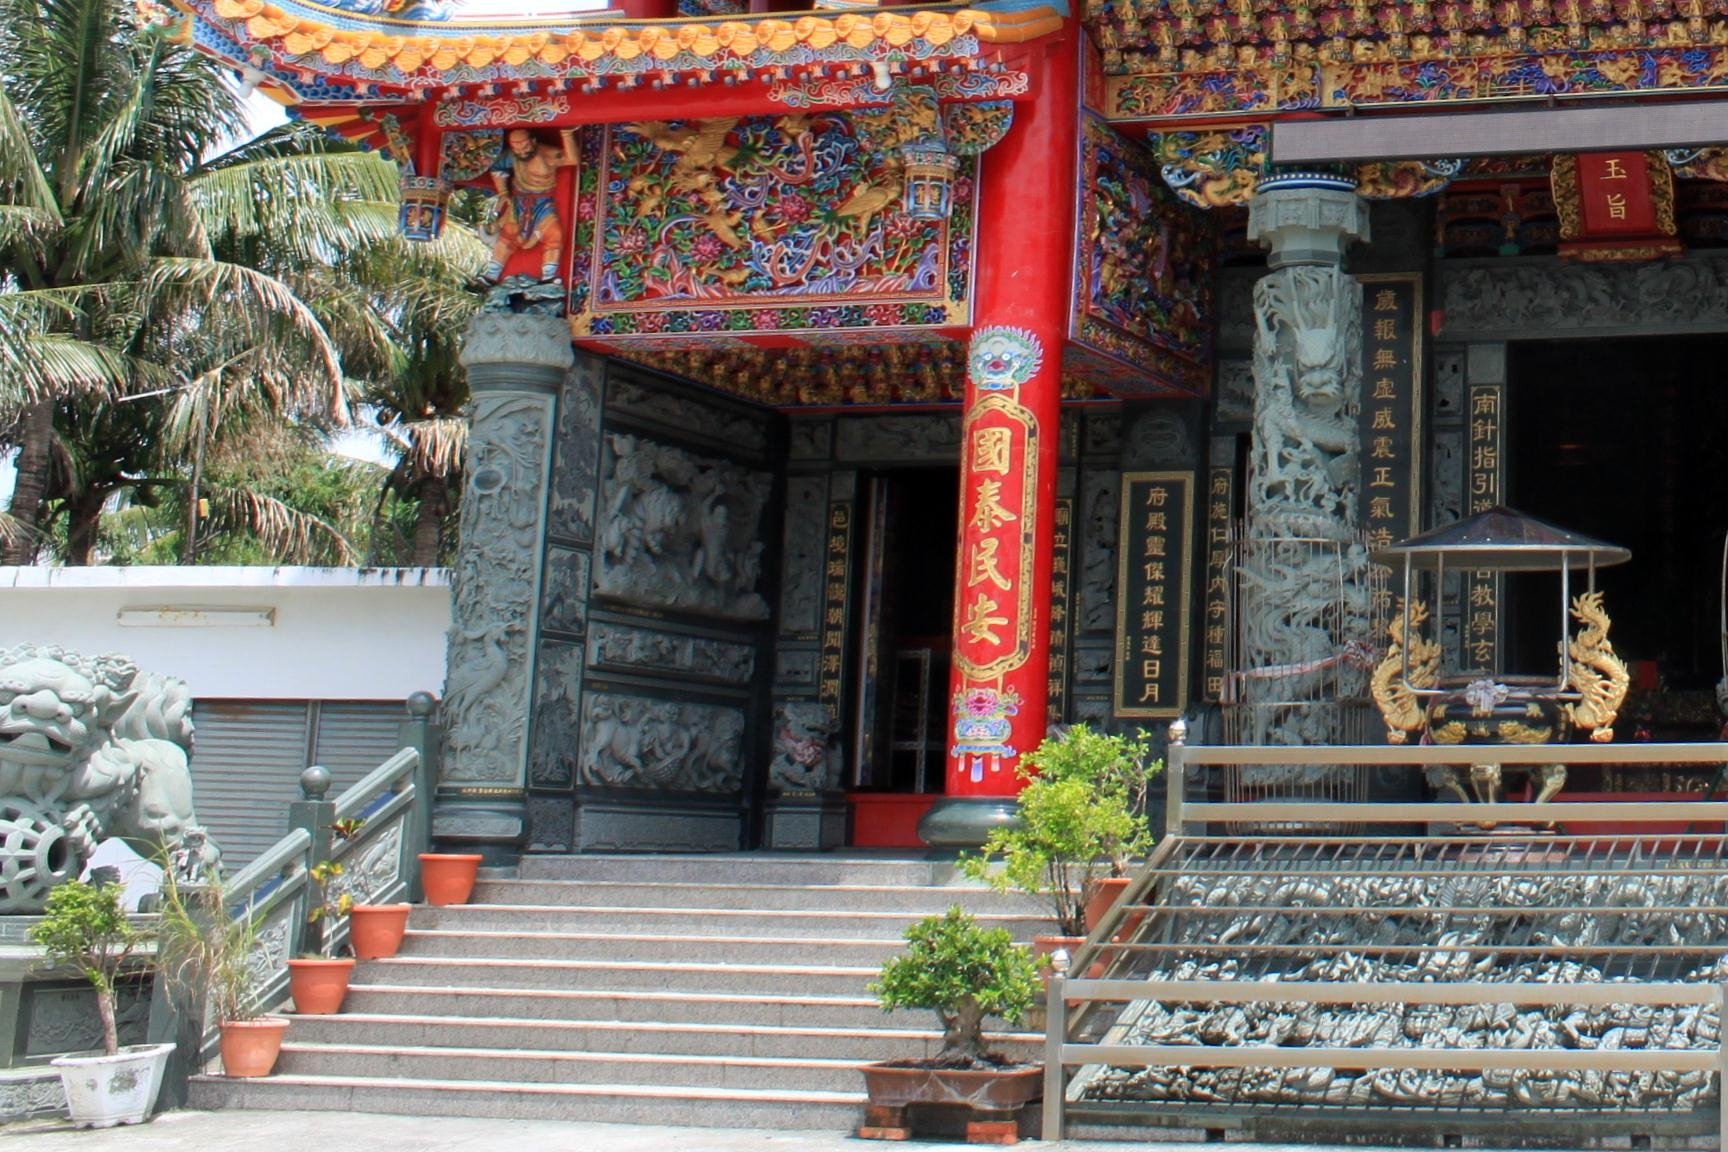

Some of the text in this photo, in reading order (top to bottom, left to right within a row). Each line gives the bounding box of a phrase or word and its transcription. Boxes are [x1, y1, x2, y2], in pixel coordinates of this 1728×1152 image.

[1600, 159, 1627, 219] 玉旨
[961, 427, 1017, 645] 國泰民安
